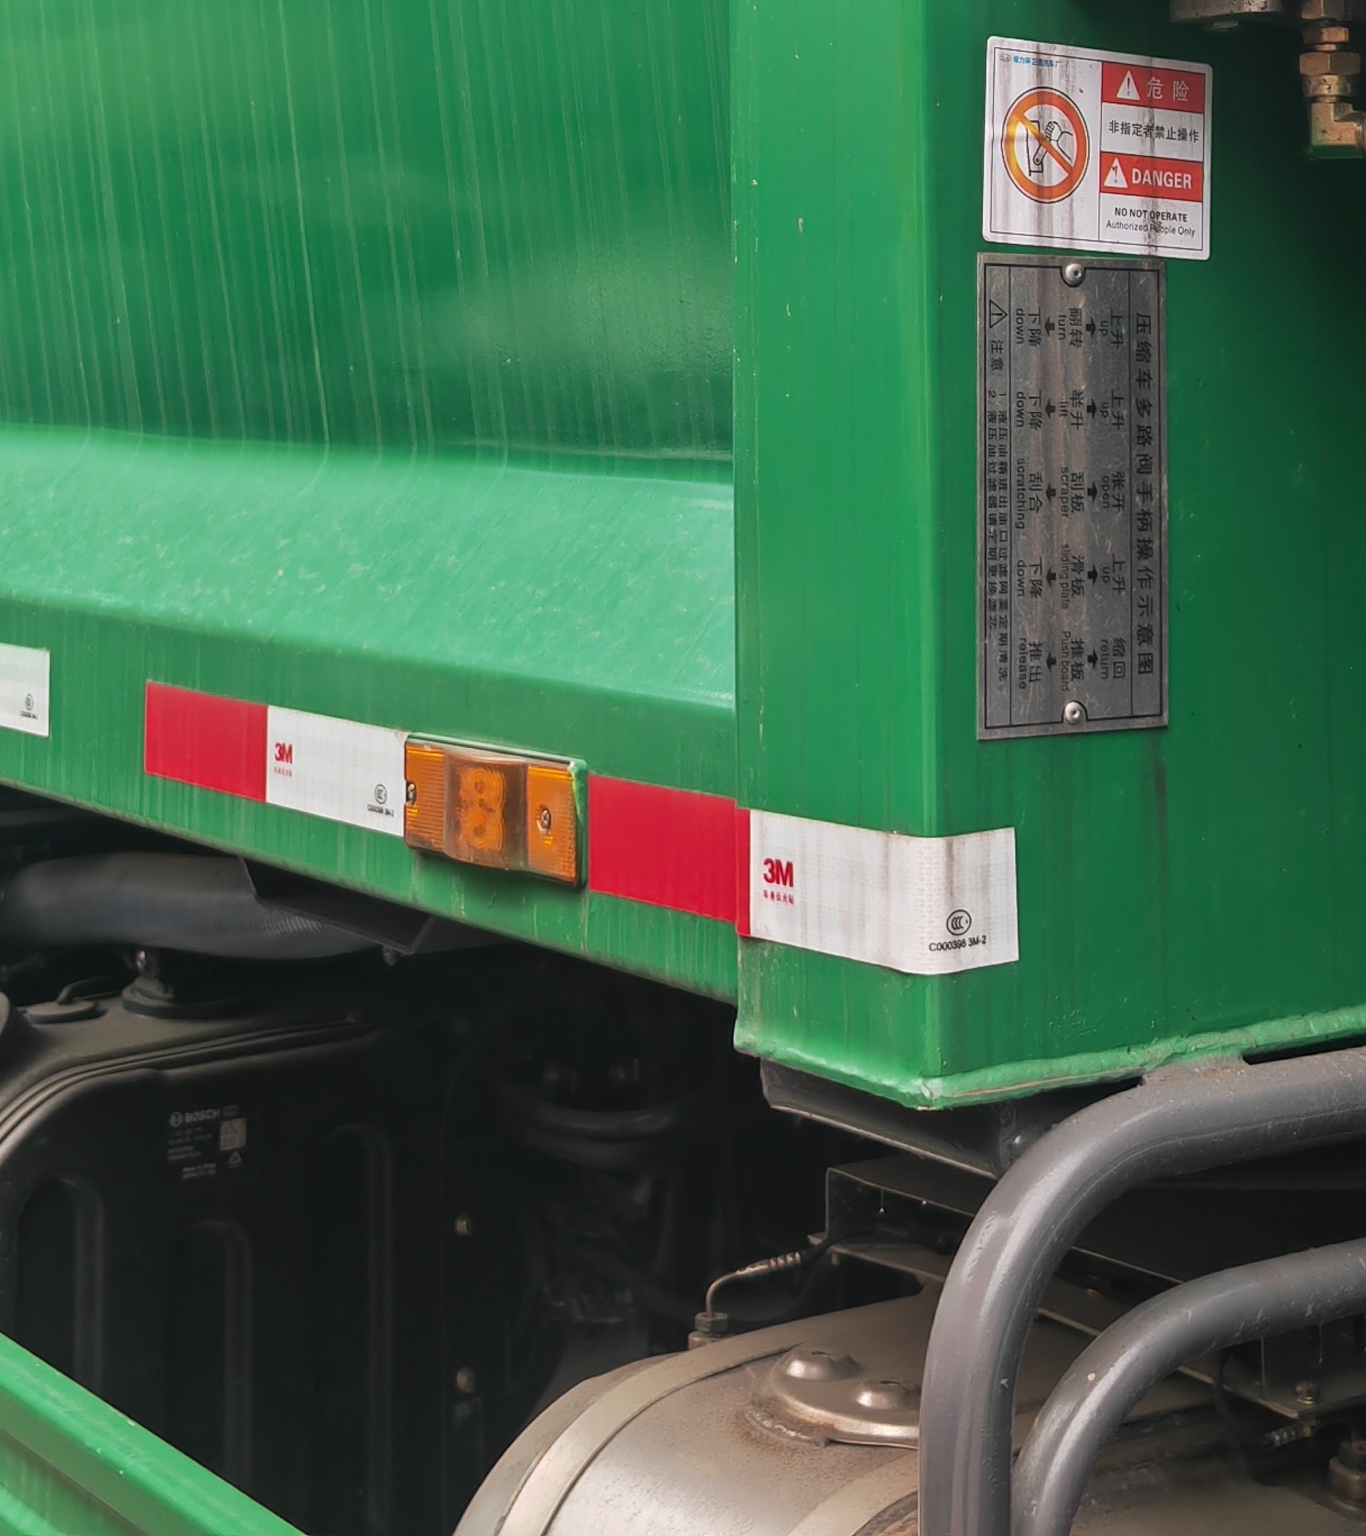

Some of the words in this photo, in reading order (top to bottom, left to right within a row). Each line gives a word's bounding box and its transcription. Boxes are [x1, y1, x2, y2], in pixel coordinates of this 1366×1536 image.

[1109, 120, 1200, 143] 非指定者禁止操作
[1131, 167, 1192, 189] DANGER
[1106, 220, 1148, 232] Authorized
[1150, 223, 1176, 237] People
[1177, 225, 1196, 238] Only
[1114, 207, 1128, 217] NO
[1129, 209, 1147, 219] NOT
[1149, 211, 1188, 223] OPERATE
[1015, 308, 1026, 345] down
[1028, 307, 1041, 347] 下降
[1058, 314, 1068, 341] turn
[1068, 307, 1083, 349] 翻转
[1099, 320, 1109, 336] up
[1110, 308, 1125, 350] 上升
[1015, 391, 1026, 428] down
[1028, 390, 1041, 430] 下降
[1058, 401, 1069, 418] lift
[1069, 389, 1083, 430] 举升
[1099, 402, 1110, 418] up
[1110, 390, 1125, 430] 上升
[1014, 458, 1028, 530] scratching
[1028, 472, 1043, 513] 刮合
[1060, 467, 1070, 518] scraper
[1070, 472, 1085, 513] 刮板
[1101, 475, 1111, 509] open
[1111, 472, 1126, 512] 张开
[1134, 312, 1154, 676] 压缩车多路阀手柄操作示意图
[1016, 560, 1027, 597] down
[1028, 556, 1043, 598] 下降
[1059, 544, 1071, 580] sliding
[1070, 555, 1085, 597] 滑板
[1101, 566, 1111, 583] up
[1111, 554, 1125, 595] 上升
[1060, 583, 1071, 609] plate
[1018, 638, 1029, 689] release
[1029, 641, 1043, 683] 推出
[1061, 631, 1071, 659] Push
[1070, 639, 1085, 681] 推板
[1100, 639, 1111, 680] return
[1111, 638, 1126, 679] 缩回
[1061, 660, 1071, 692] board
[274, 742, 293, 764] 3M
[763, 857, 794, 887] 3M
[967, 934, 987, 947] 3M-2
